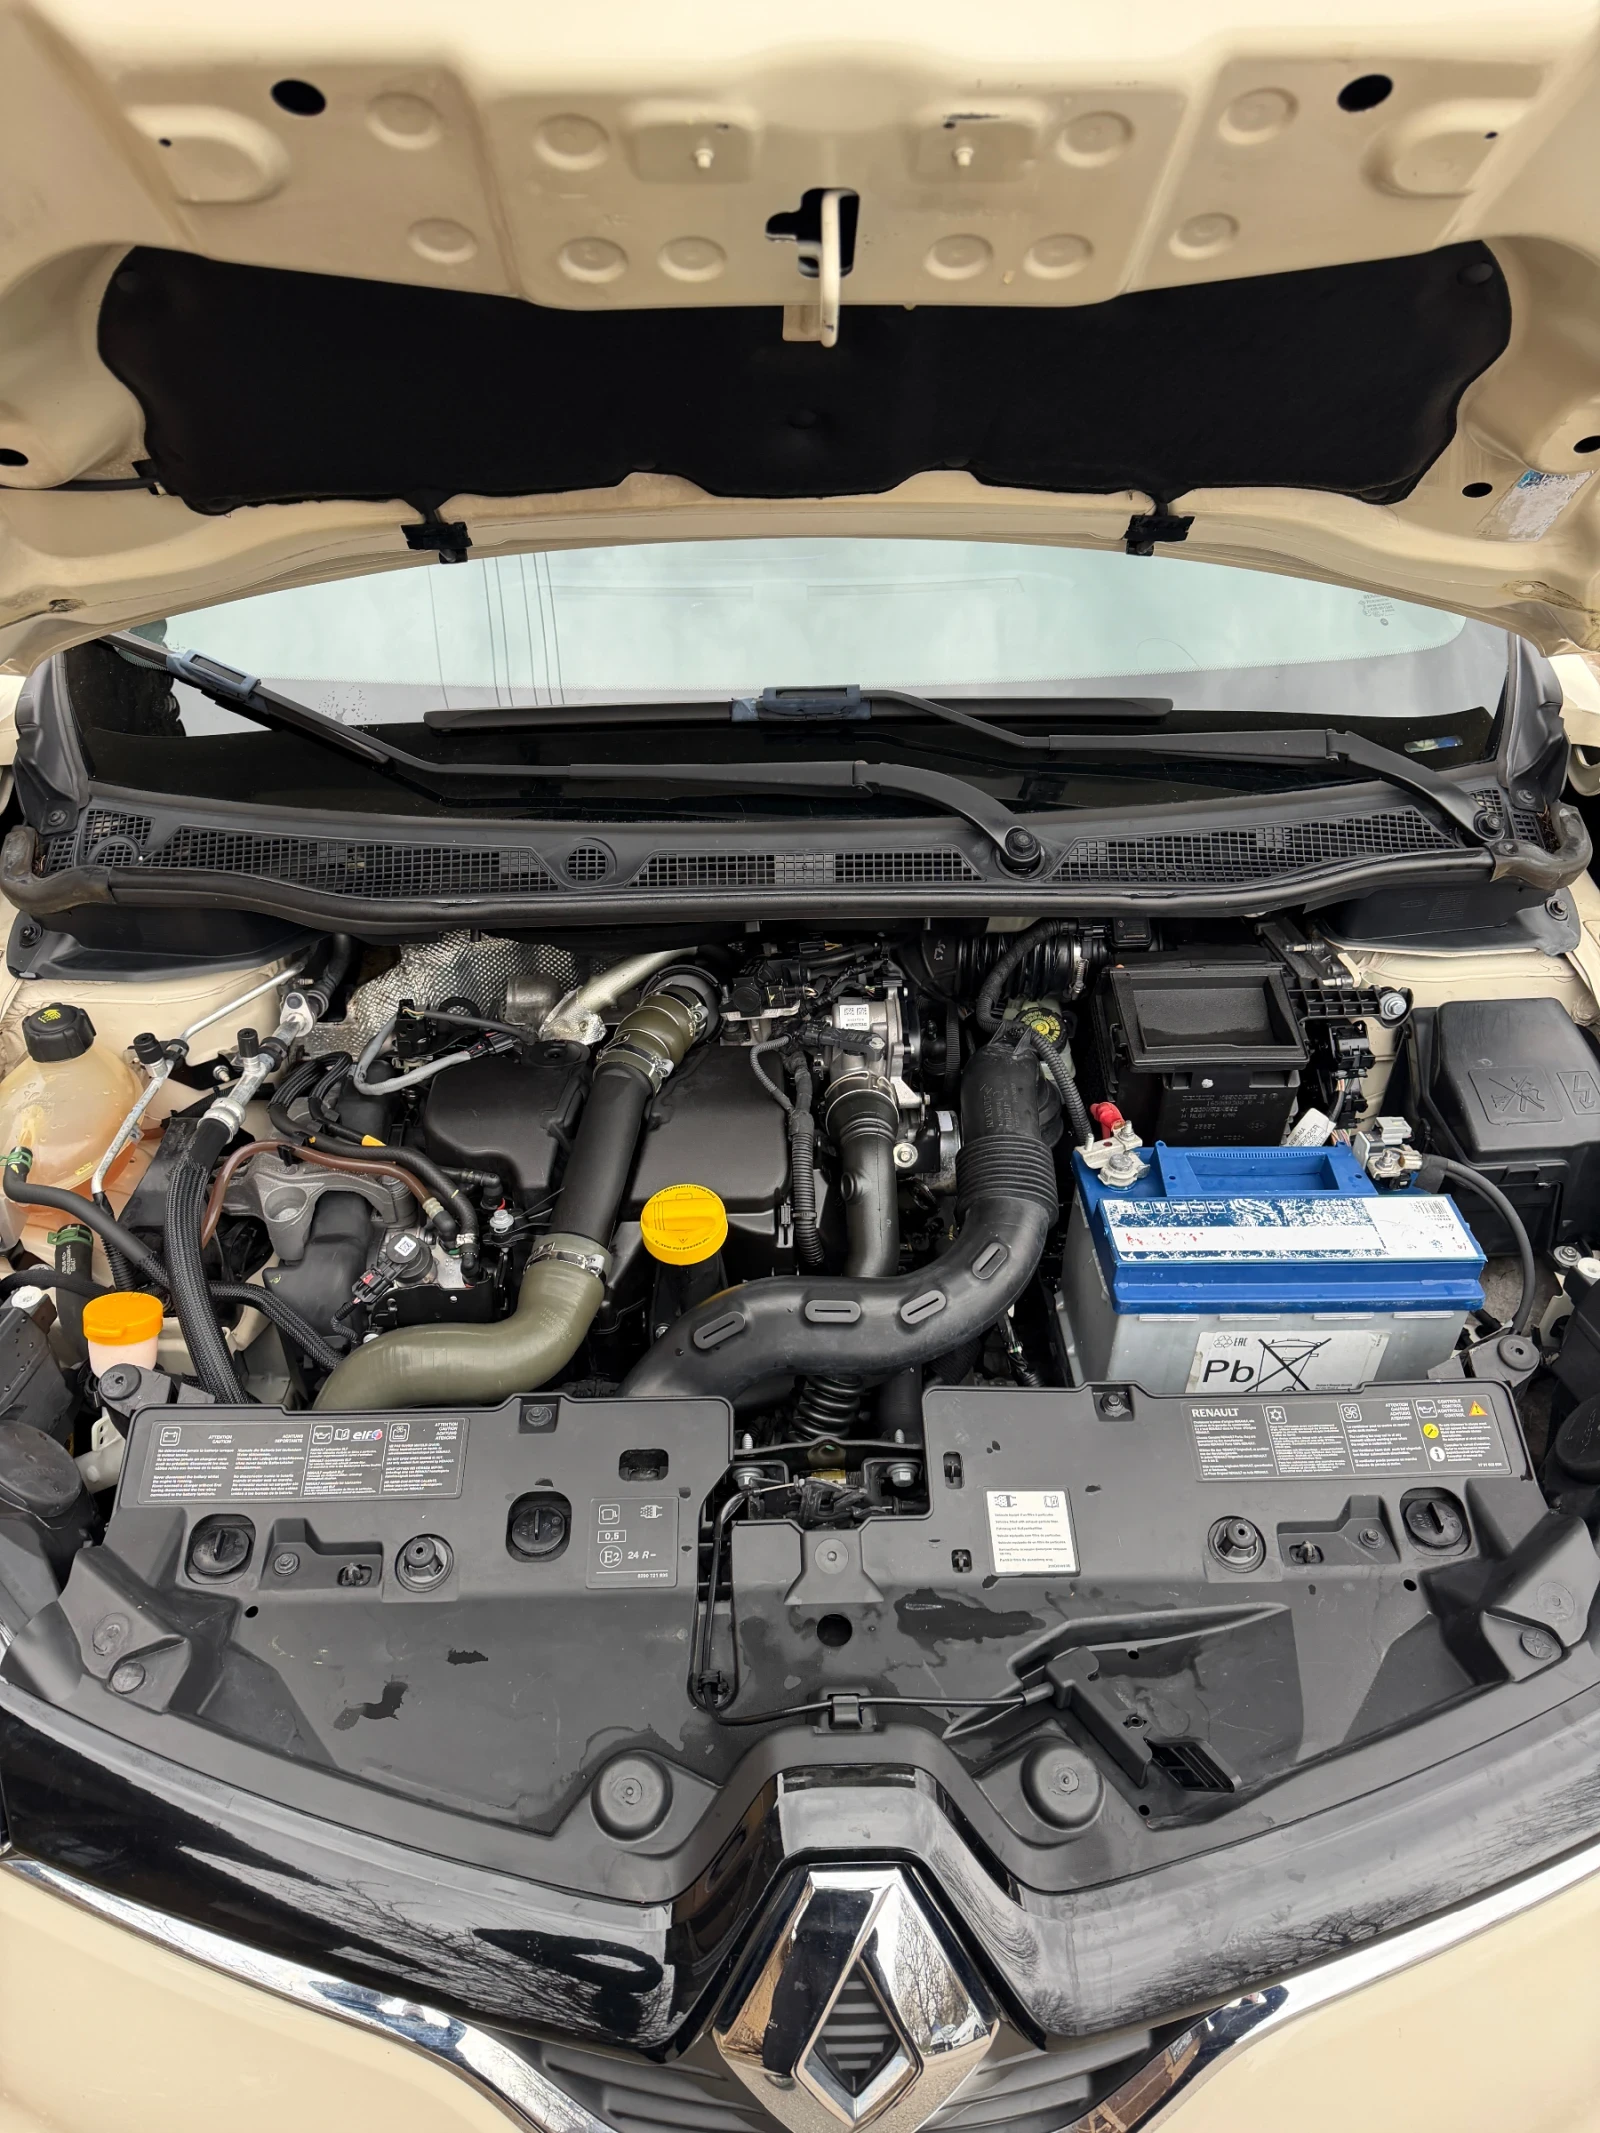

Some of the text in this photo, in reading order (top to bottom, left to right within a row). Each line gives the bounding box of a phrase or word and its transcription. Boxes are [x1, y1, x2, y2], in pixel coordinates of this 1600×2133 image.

[1202, 1359, 1254, 1383] Pb
[1191, 1408, 1239, 1417] RENAULT
[352, 1430, 372, 1440] elf
[604, 1532, 620, 1541] 0,5
[604, 1550, 620, 1564] E2
[627, 1551, 639, 1559] 24
